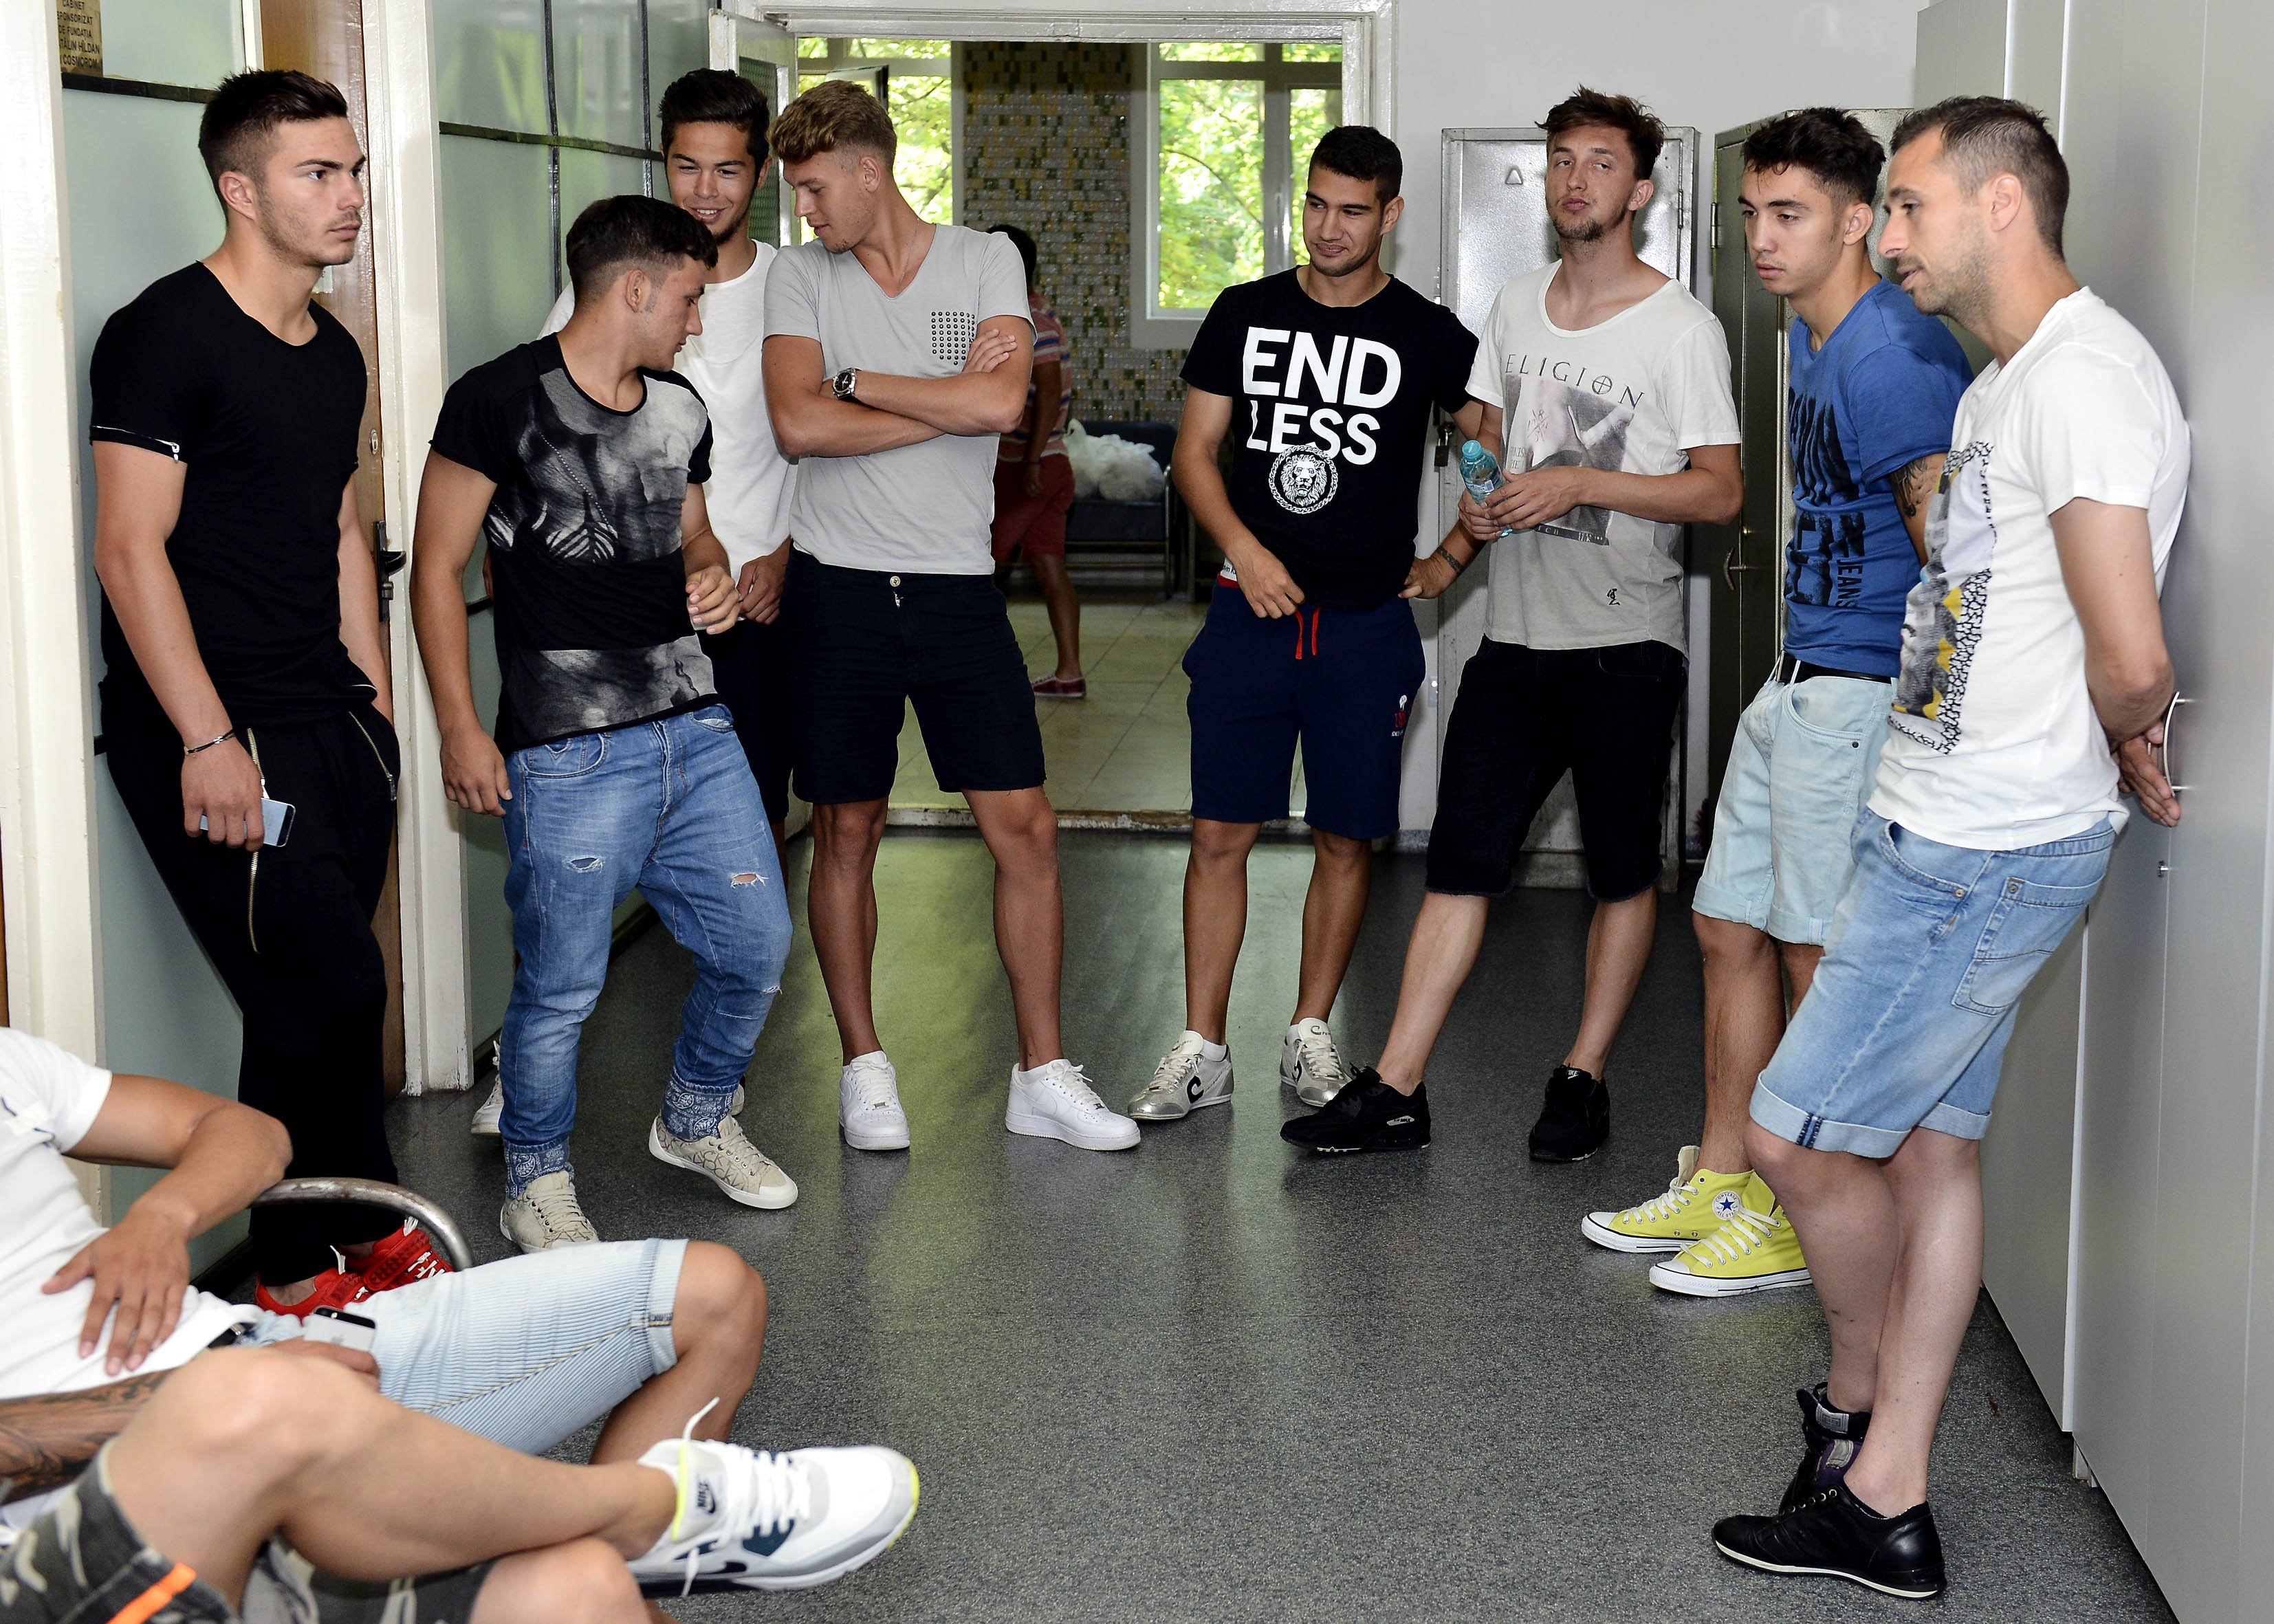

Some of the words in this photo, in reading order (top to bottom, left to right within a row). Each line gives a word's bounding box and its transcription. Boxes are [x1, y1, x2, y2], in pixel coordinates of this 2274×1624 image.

[1243, 326, 1401, 408] END
[1505, 353, 1645, 410] ELIGION
[1246, 399, 1381, 465] LESS
[1835, 559, 1863, 608] JEANS
[1716, 1193, 1737, 1202] CONVERSE
